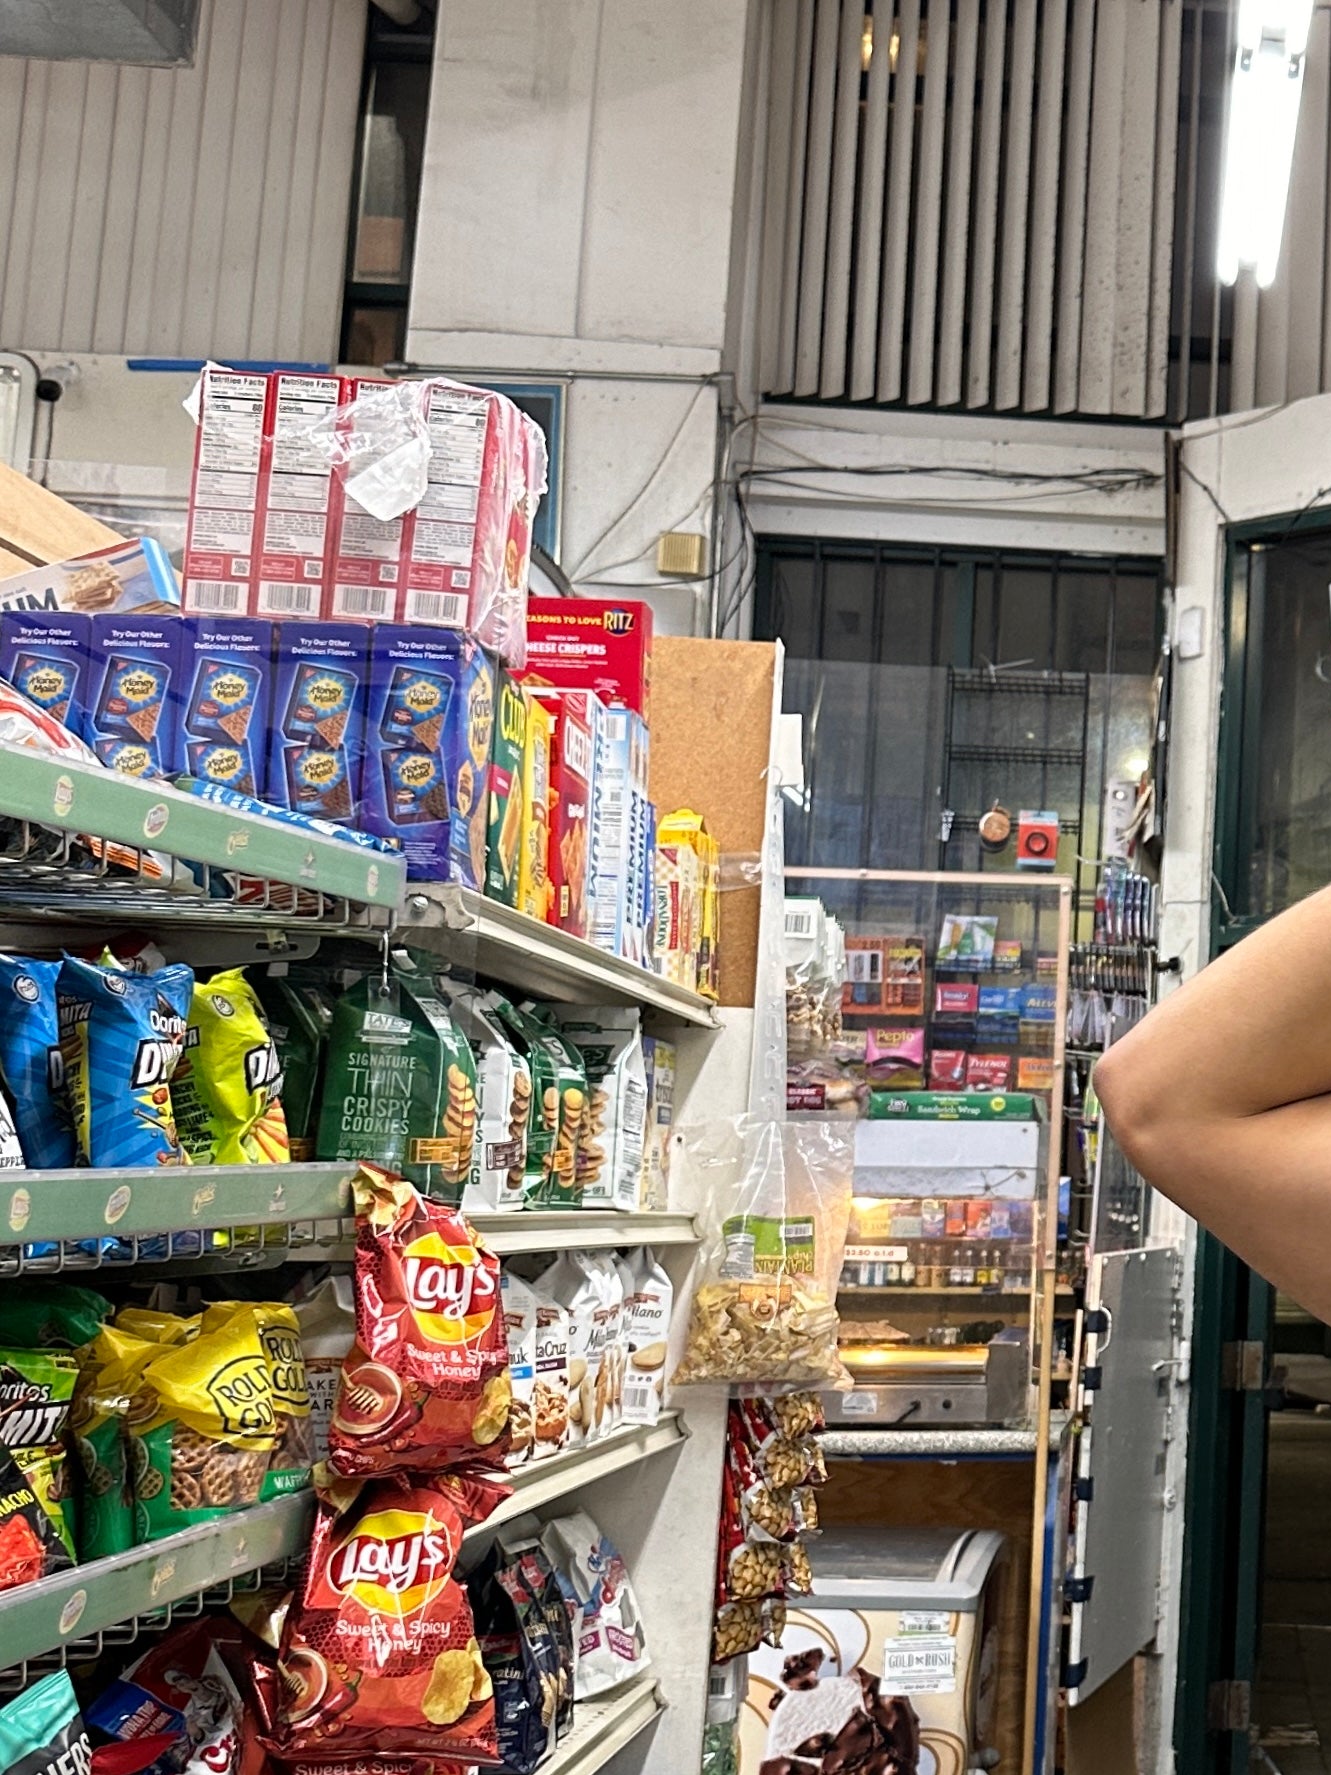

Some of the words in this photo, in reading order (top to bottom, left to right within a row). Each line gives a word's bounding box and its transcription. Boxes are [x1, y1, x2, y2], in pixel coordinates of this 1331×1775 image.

[563, 616, 577, 625] TO
[577, 616, 602, 626] LOVE
[603, 609, 635, 632] RITZ
[20, 626, 33, 637] Try
[48, 628, 72, 637] Other
[112, 630, 125, 640] Try
[140, 631, 164, 640] Other
[202, 633, 216, 643] Try
[231, 634, 253, 643] Other
[300, 638, 314, 648] Try
[328, 639, 351, 648] Other
[397, 641, 411, 651] Try
[425, 642, 448, 651] Other
[526, 642, 558, 654] HEESE
[28, 674, 63, 688] Honey
[121, 677, 156, 690] Honey
[212, 680, 246, 693] Honey
[33, 683, 58, 694] Maid
[125, 686, 151, 697] Maid
[216, 688, 241, 699] Maid
[309, 686, 342, 698] Honey
[405, 687, 441, 699] Honey
[314, 694, 338, 704] Maid
[410, 696, 433, 706] Maid
[115, 751, 147, 770] Honey
[206, 753, 239, 771] Honey
[303, 758, 335, 776] Honey
[400, 761, 432, 777] Honey
[877, 1029, 915, 1042] Pepto
[348, 1052, 417, 1070] SIGNATURE
[347, 1067, 414, 1098] THIN
[344, 1096, 412, 1118] CRISPY
[342, 1116, 410, 1135] COOKIES
[406, 1258, 497, 1320] Lay's
[407, 1343, 447, 1364] Sweet
[433, 1361, 481, 1381] Honey
[338, 1528, 447, 1595] Lay's
[409, 1619, 450, 1640] Spicy
[367, 1637, 422, 1655] Honey
[888, 1653, 914, 1668] GOLD
[924, 1652, 951, 1667] RUSH
